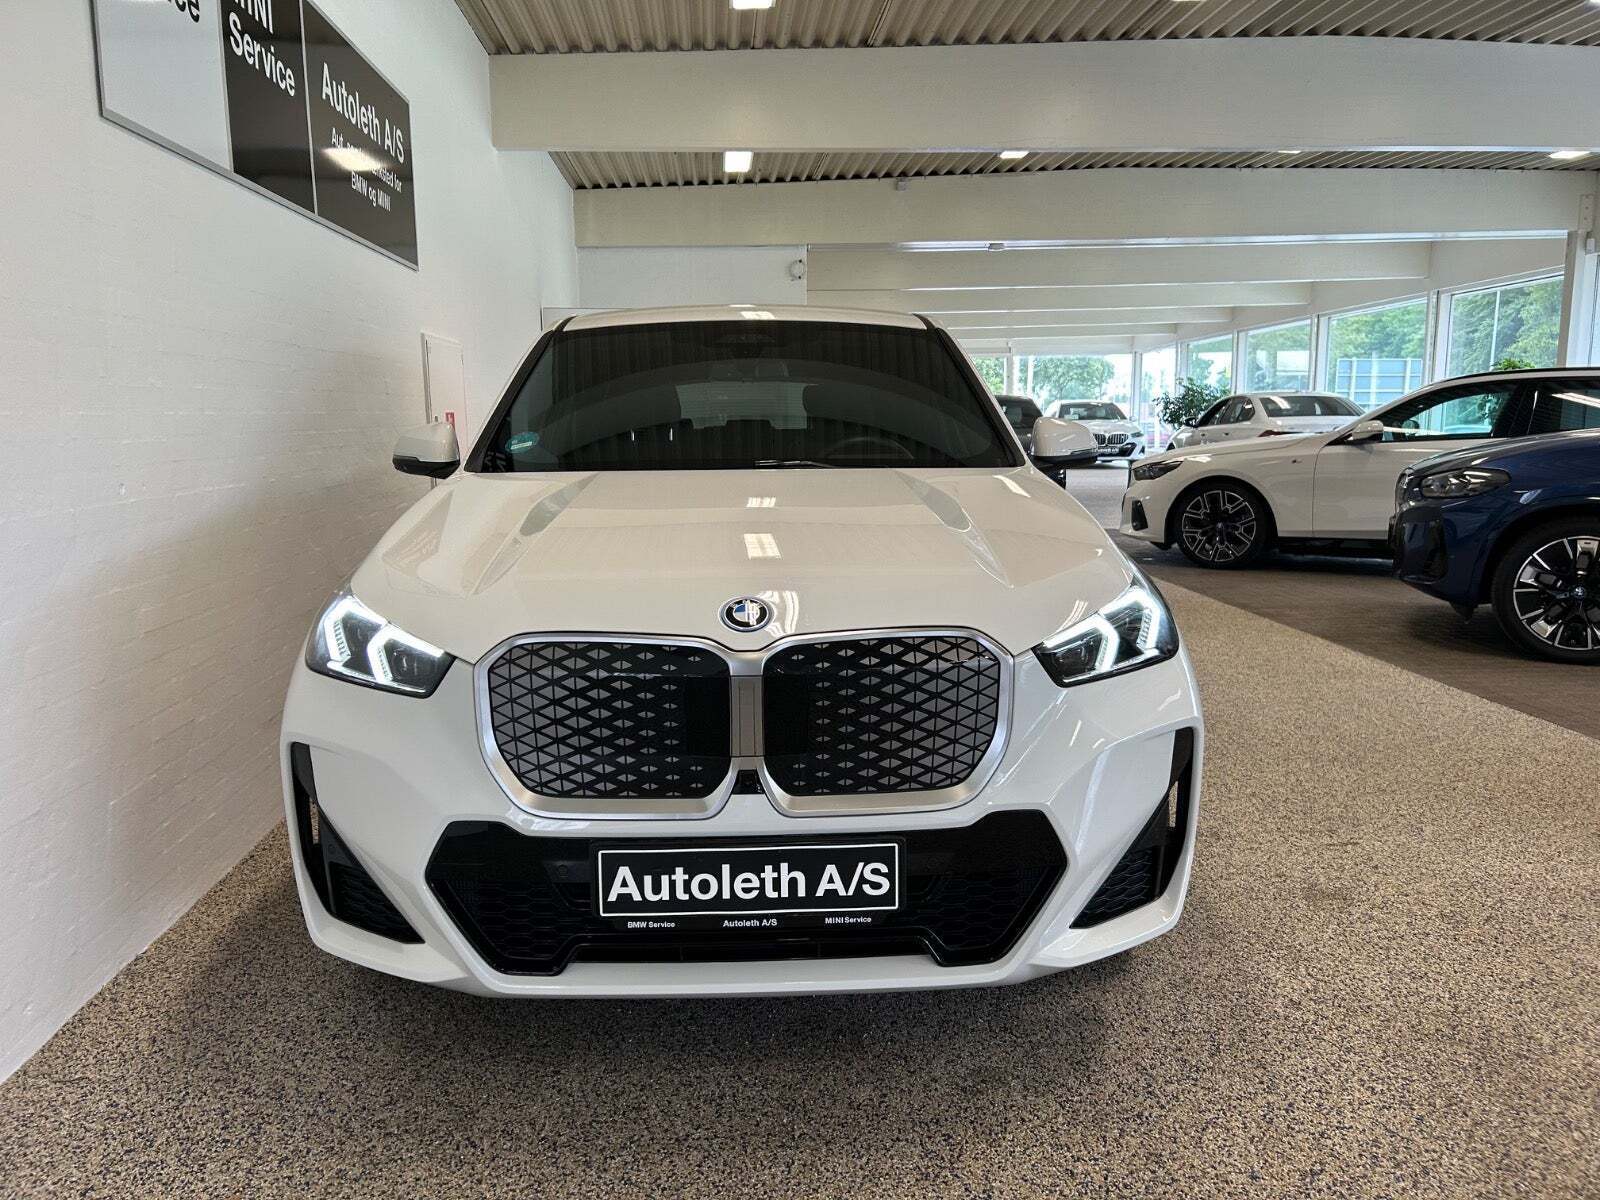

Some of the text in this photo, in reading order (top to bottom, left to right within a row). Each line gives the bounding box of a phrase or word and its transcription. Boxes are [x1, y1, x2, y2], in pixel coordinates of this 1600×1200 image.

[229, 11, 295, 97] Service
[322, 61, 404, 164] Autoleth A/S
[351, 170, 391, 212] BMW og MINI
[606, 861, 891, 902] Autoleth A/S
[627, 921, 647, 929] BMW
[722, 918, 778, 927] Autoleth A/S
[825, 916, 872, 924] MINI Service
